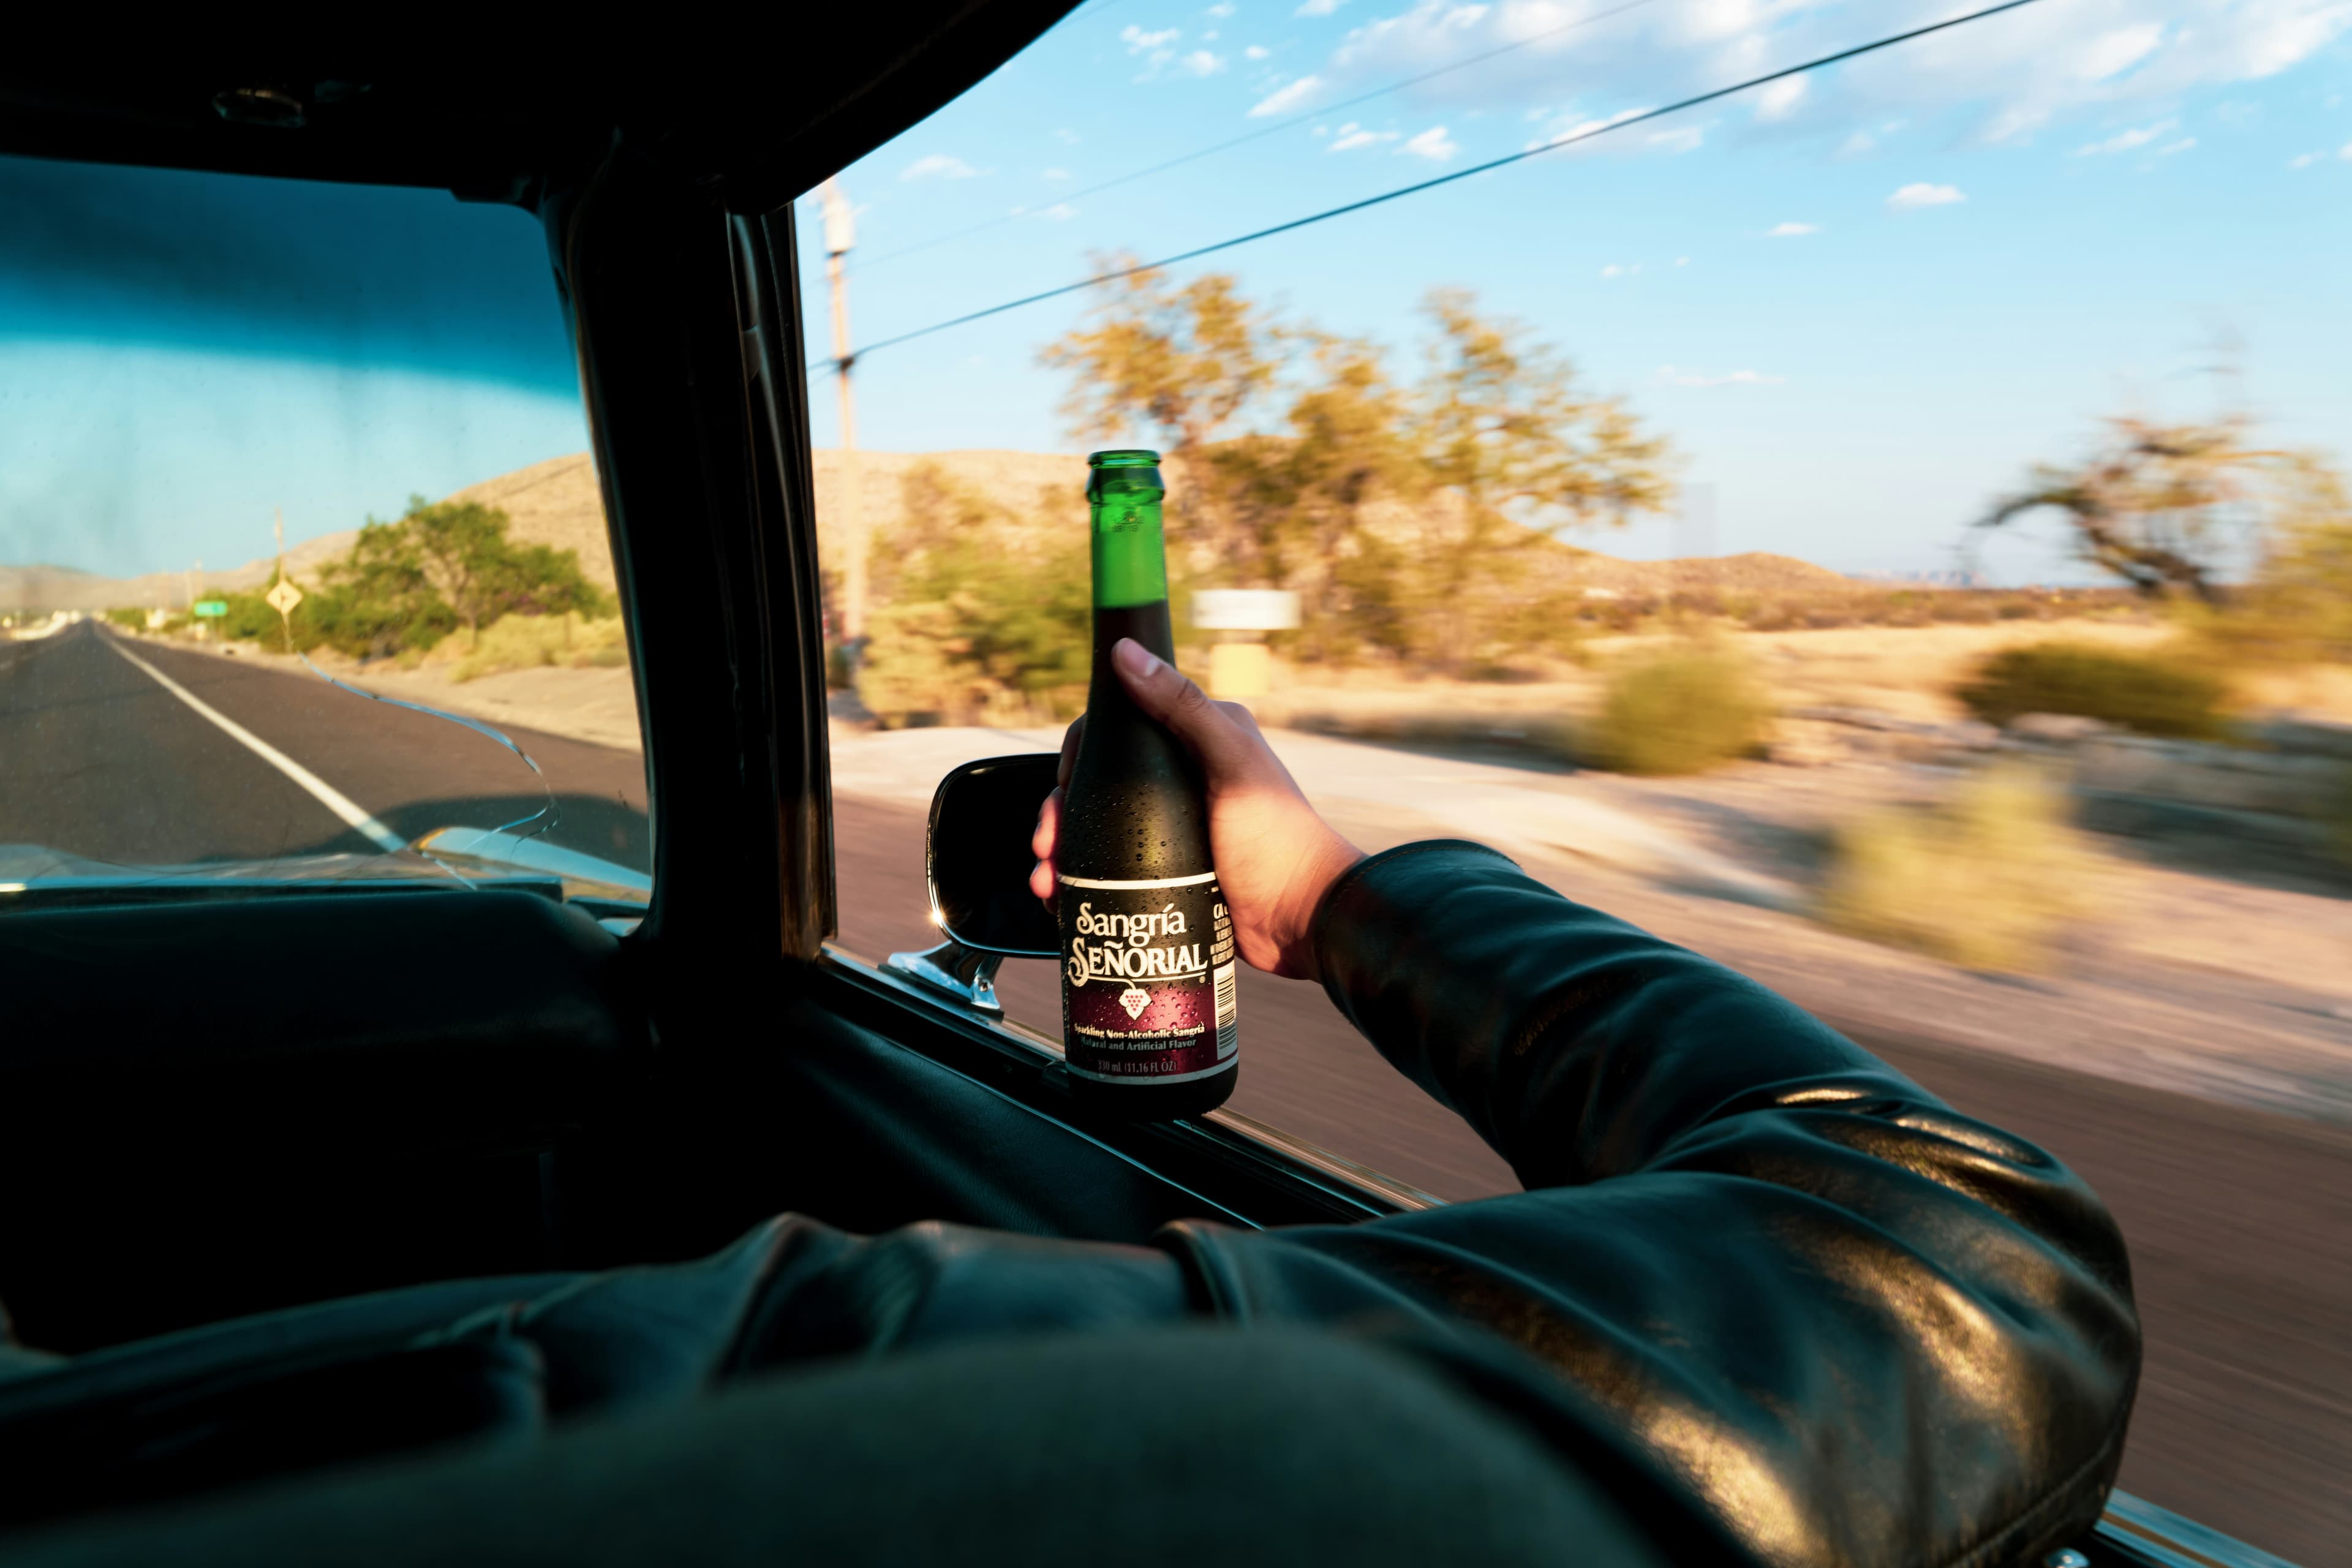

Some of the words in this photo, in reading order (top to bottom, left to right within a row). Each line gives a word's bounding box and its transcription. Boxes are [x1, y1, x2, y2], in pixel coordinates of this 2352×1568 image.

[1076, 902, 1187, 948] Sangría
[1068, 937, 1208, 987] SEÑORIAL
[1074, 1023, 1105, 1039] Sparkling
[1106, 1029, 1172, 1039] Non-Alcoholic
[1173, 1023, 1205, 1038] Sangría
[1081, 1036, 1106, 1049] Natural
[1109, 1041, 1125, 1050] and
[1127, 1041, 1166, 1051] Artificial
[1169, 1039, 1197, 1049] Flavor
[1098, 1060, 1110, 1072] 330
[1124, 1062, 1148, 1073] (11.16
[1150, 1062, 1159, 1072] FL
[1161, 1060, 1177, 1072] OZ)
